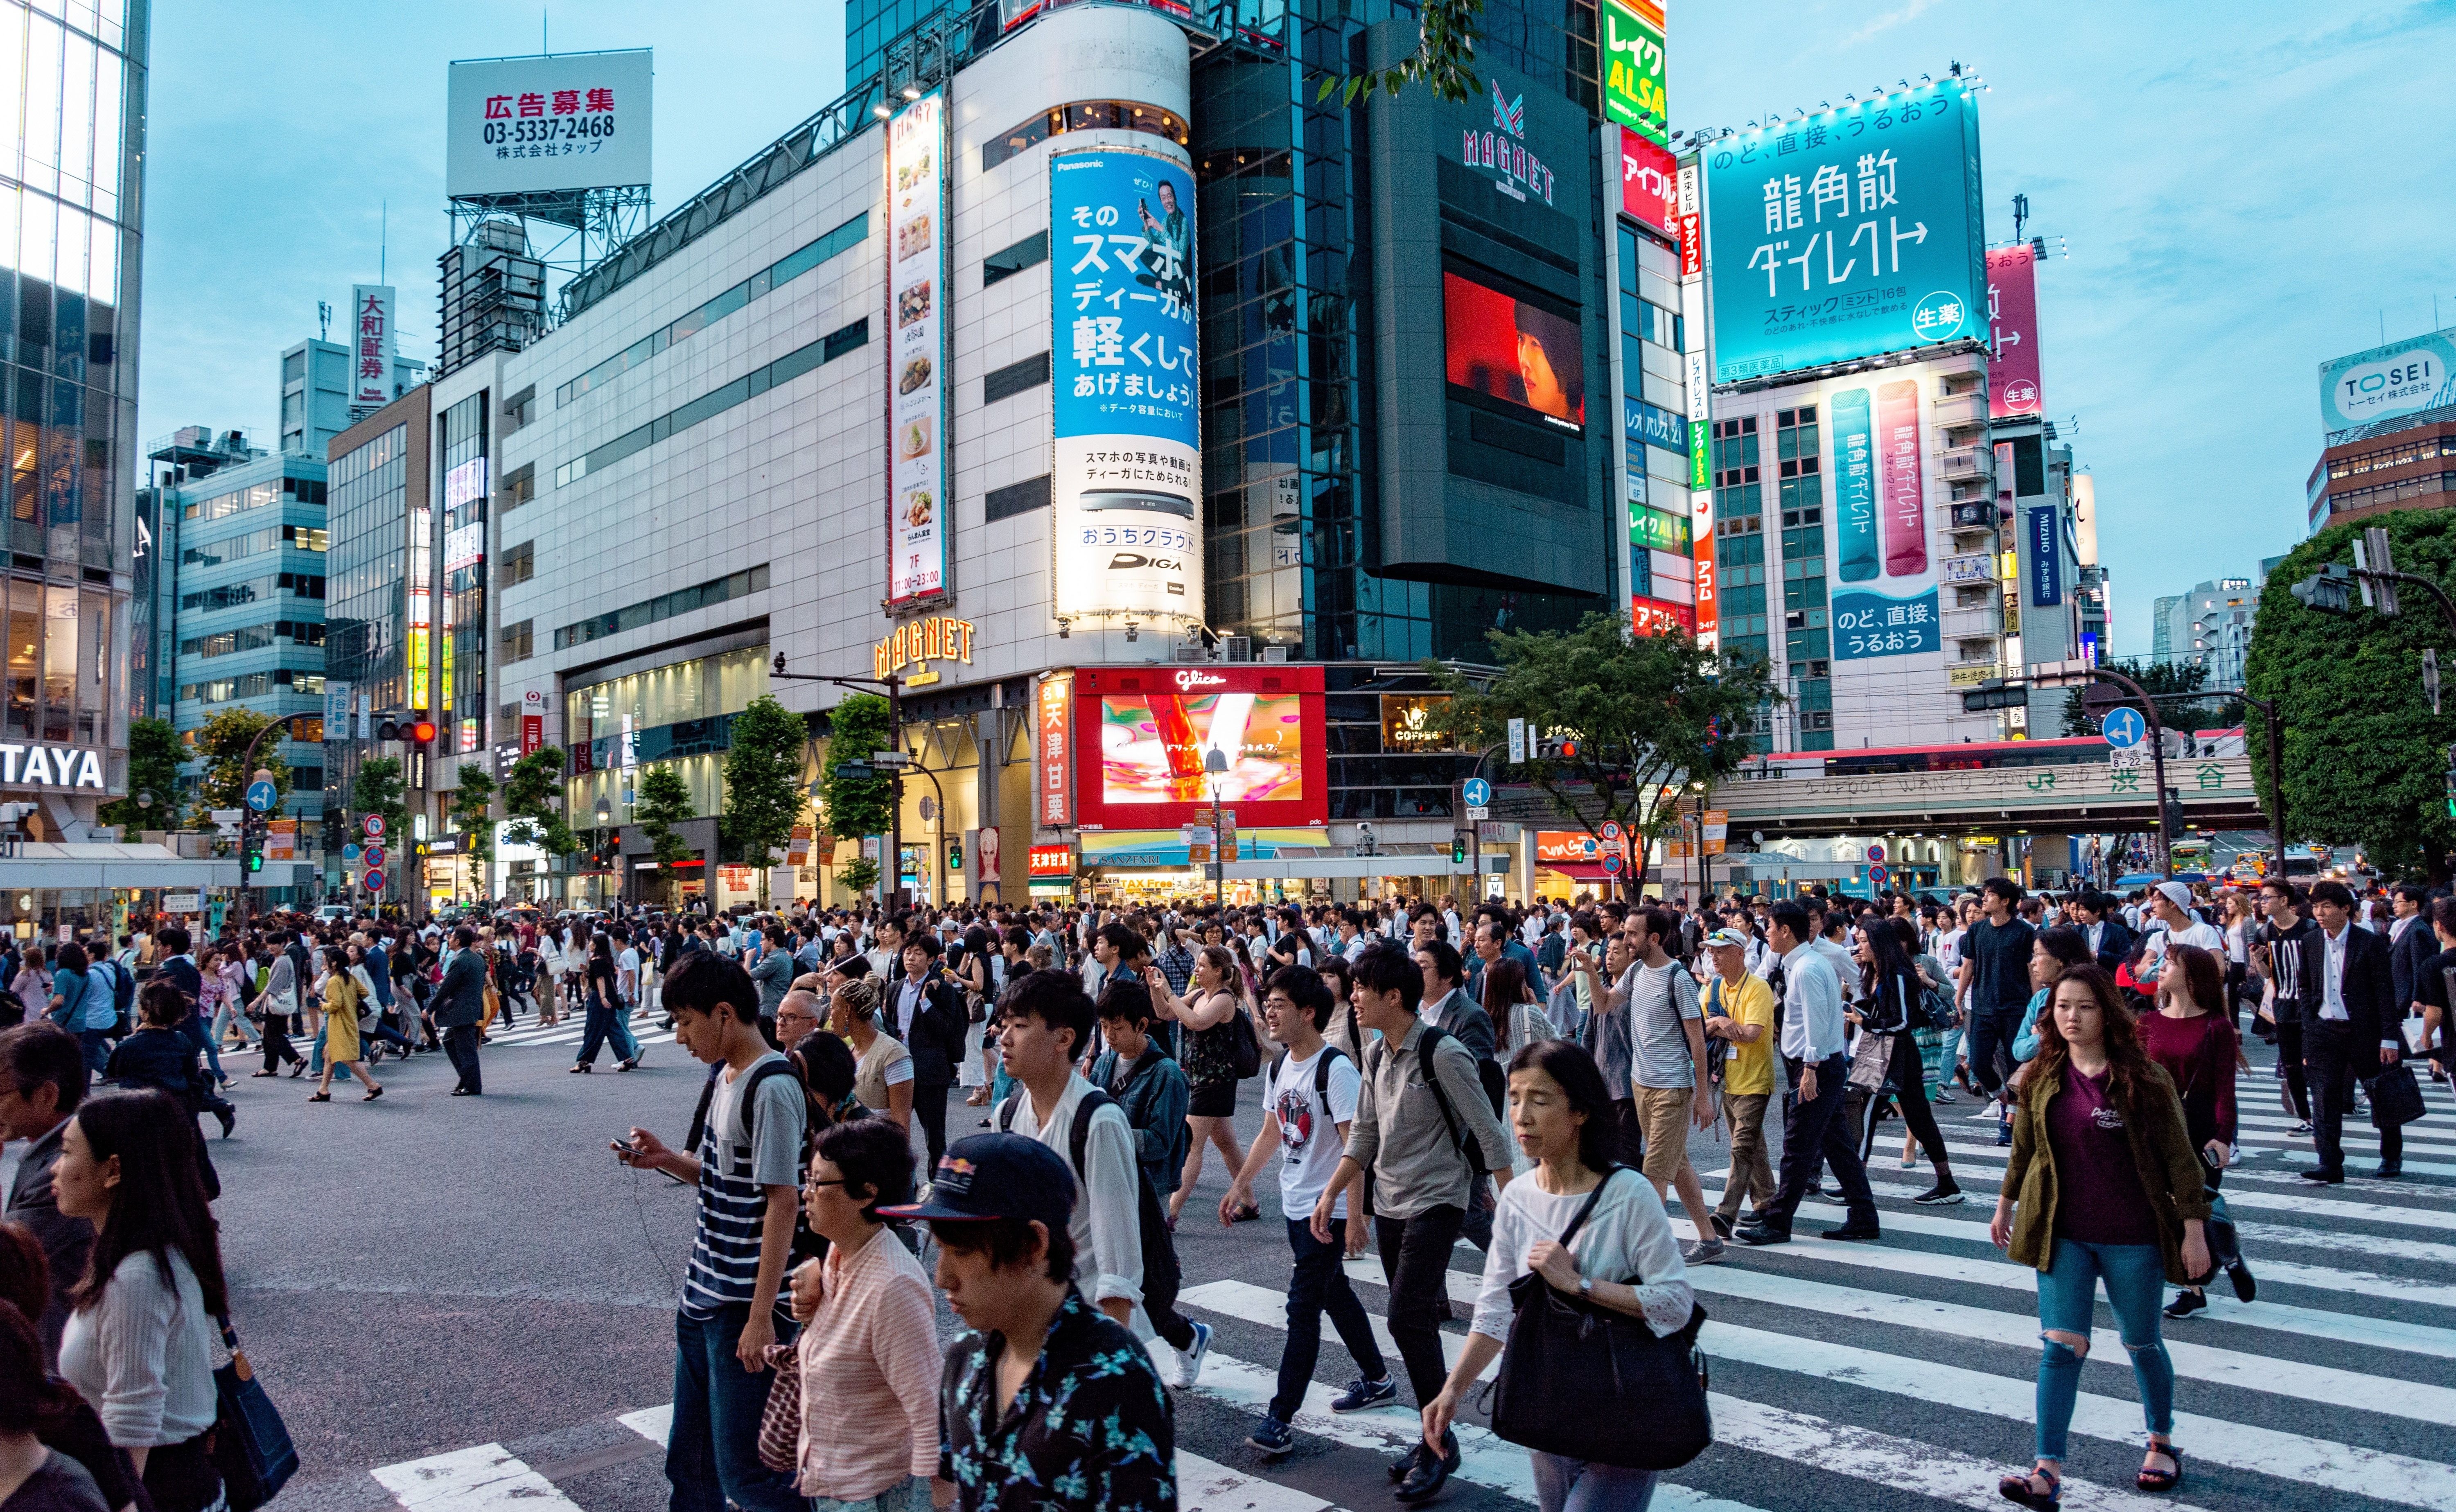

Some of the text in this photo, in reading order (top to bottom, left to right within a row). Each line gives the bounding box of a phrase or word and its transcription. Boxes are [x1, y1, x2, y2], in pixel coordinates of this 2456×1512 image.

[1608, 14, 1662, 77] レイク
[484, 88, 614, 120] 広告募集
[1608, 60, 1666, 120] ALSA
[484, 115, 614, 144] 03-5337-2468
[1714, 94, 1949, 170] のど、直接、うるおう
[497, 140, 602, 160] 株式会社タップ
[1057, 160, 1104, 172] Panasonic
[1464, 130, 1554, 206] MAGNET
[1623, 153, 1677, 204] アイフル
[1683, 170, 1693, 211] 榮來ビル
[1763, 148, 1900, 235] 龍角散
[1072, 205, 1119, 228] その
[1664, 216, 1678, 235] 8F
[1685, 228, 1698, 274] アイフル
[1747, 216, 1928, 298] ダイレクト
[1072, 279, 1192, 324] ディーガが
[1845, 293, 1877, 307] ミント
[1881, 287, 1907, 300] 16包
[1764, 302, 1908, 336] のどのあれ・不快感に水なしで飲める
[1765, 296, 1839, 325] スティック
[1916, 303, 1961, 329] 生薬
[360, 294, 385, 379] 大和証券
[1073, 316, 1193, 379] 軽くして
[1720, 357, 1781, 379] 第3類医薬品
[2345, 361, 2429, 396] TOSEI
[1074, 372, 1194, 409] あげましょう!
[1693, 356, 1702, 418] レオパレス21
[2006, 388, 2036, 403] 生薬
[2349, 393, 2385, 410] トーセイ
[2388, 381, 2431, 400] 株式会社
[1627, 408, 1682, 445] レオパレス21
[1695, 422, 1704, 449] レイク
[1086, 451, 1191, 472] スマホの写真や動画は
[1695, 449, 1705, 484] ALSA
[1894, 425, 1918, 527] 龍角散ダイレクト
[2353, 466, 2370, 475] エステ
[1087, 468, 1191, 488] ディーガにためられる!
[1847, 433, 1870, 533] 龍角散ダイレクト
[1633, 489, 1640, 498] 6F
[1629, 512, 1657, 534] レイク
[2040, 514, 2050, 553] MIZUHO
[1084, 528, 1194, 551] おうちクラウド
[910, 554, 919, 569] 7F
[1108, 553, 1182, 571] DIGA
[1698, 560, 1713, 601] アコム
[1838, 604, 1938, 630] のど、直接、
[875, 617, 973, 680] MAGNET
[1849, 630, 1923, 654] うるおう
[2009, 670, 2020, 678] 3F
[335, 687, 346, 734] 渋谷駅前
[0, 743, 104, 788] TAYA
[1046, 702, 1064, 820] 天津甘栗
[2027, 774, 2056, 789] JR
[1481, 823, 1506, 837] AGNET
[1031, 852, 1068, 868] 天津甘栗
[1101, 855, 1160, 864] SANZENRI
[1120, 879, 1144, 888] TAX
[1147, 879, 1173, 888] Free
